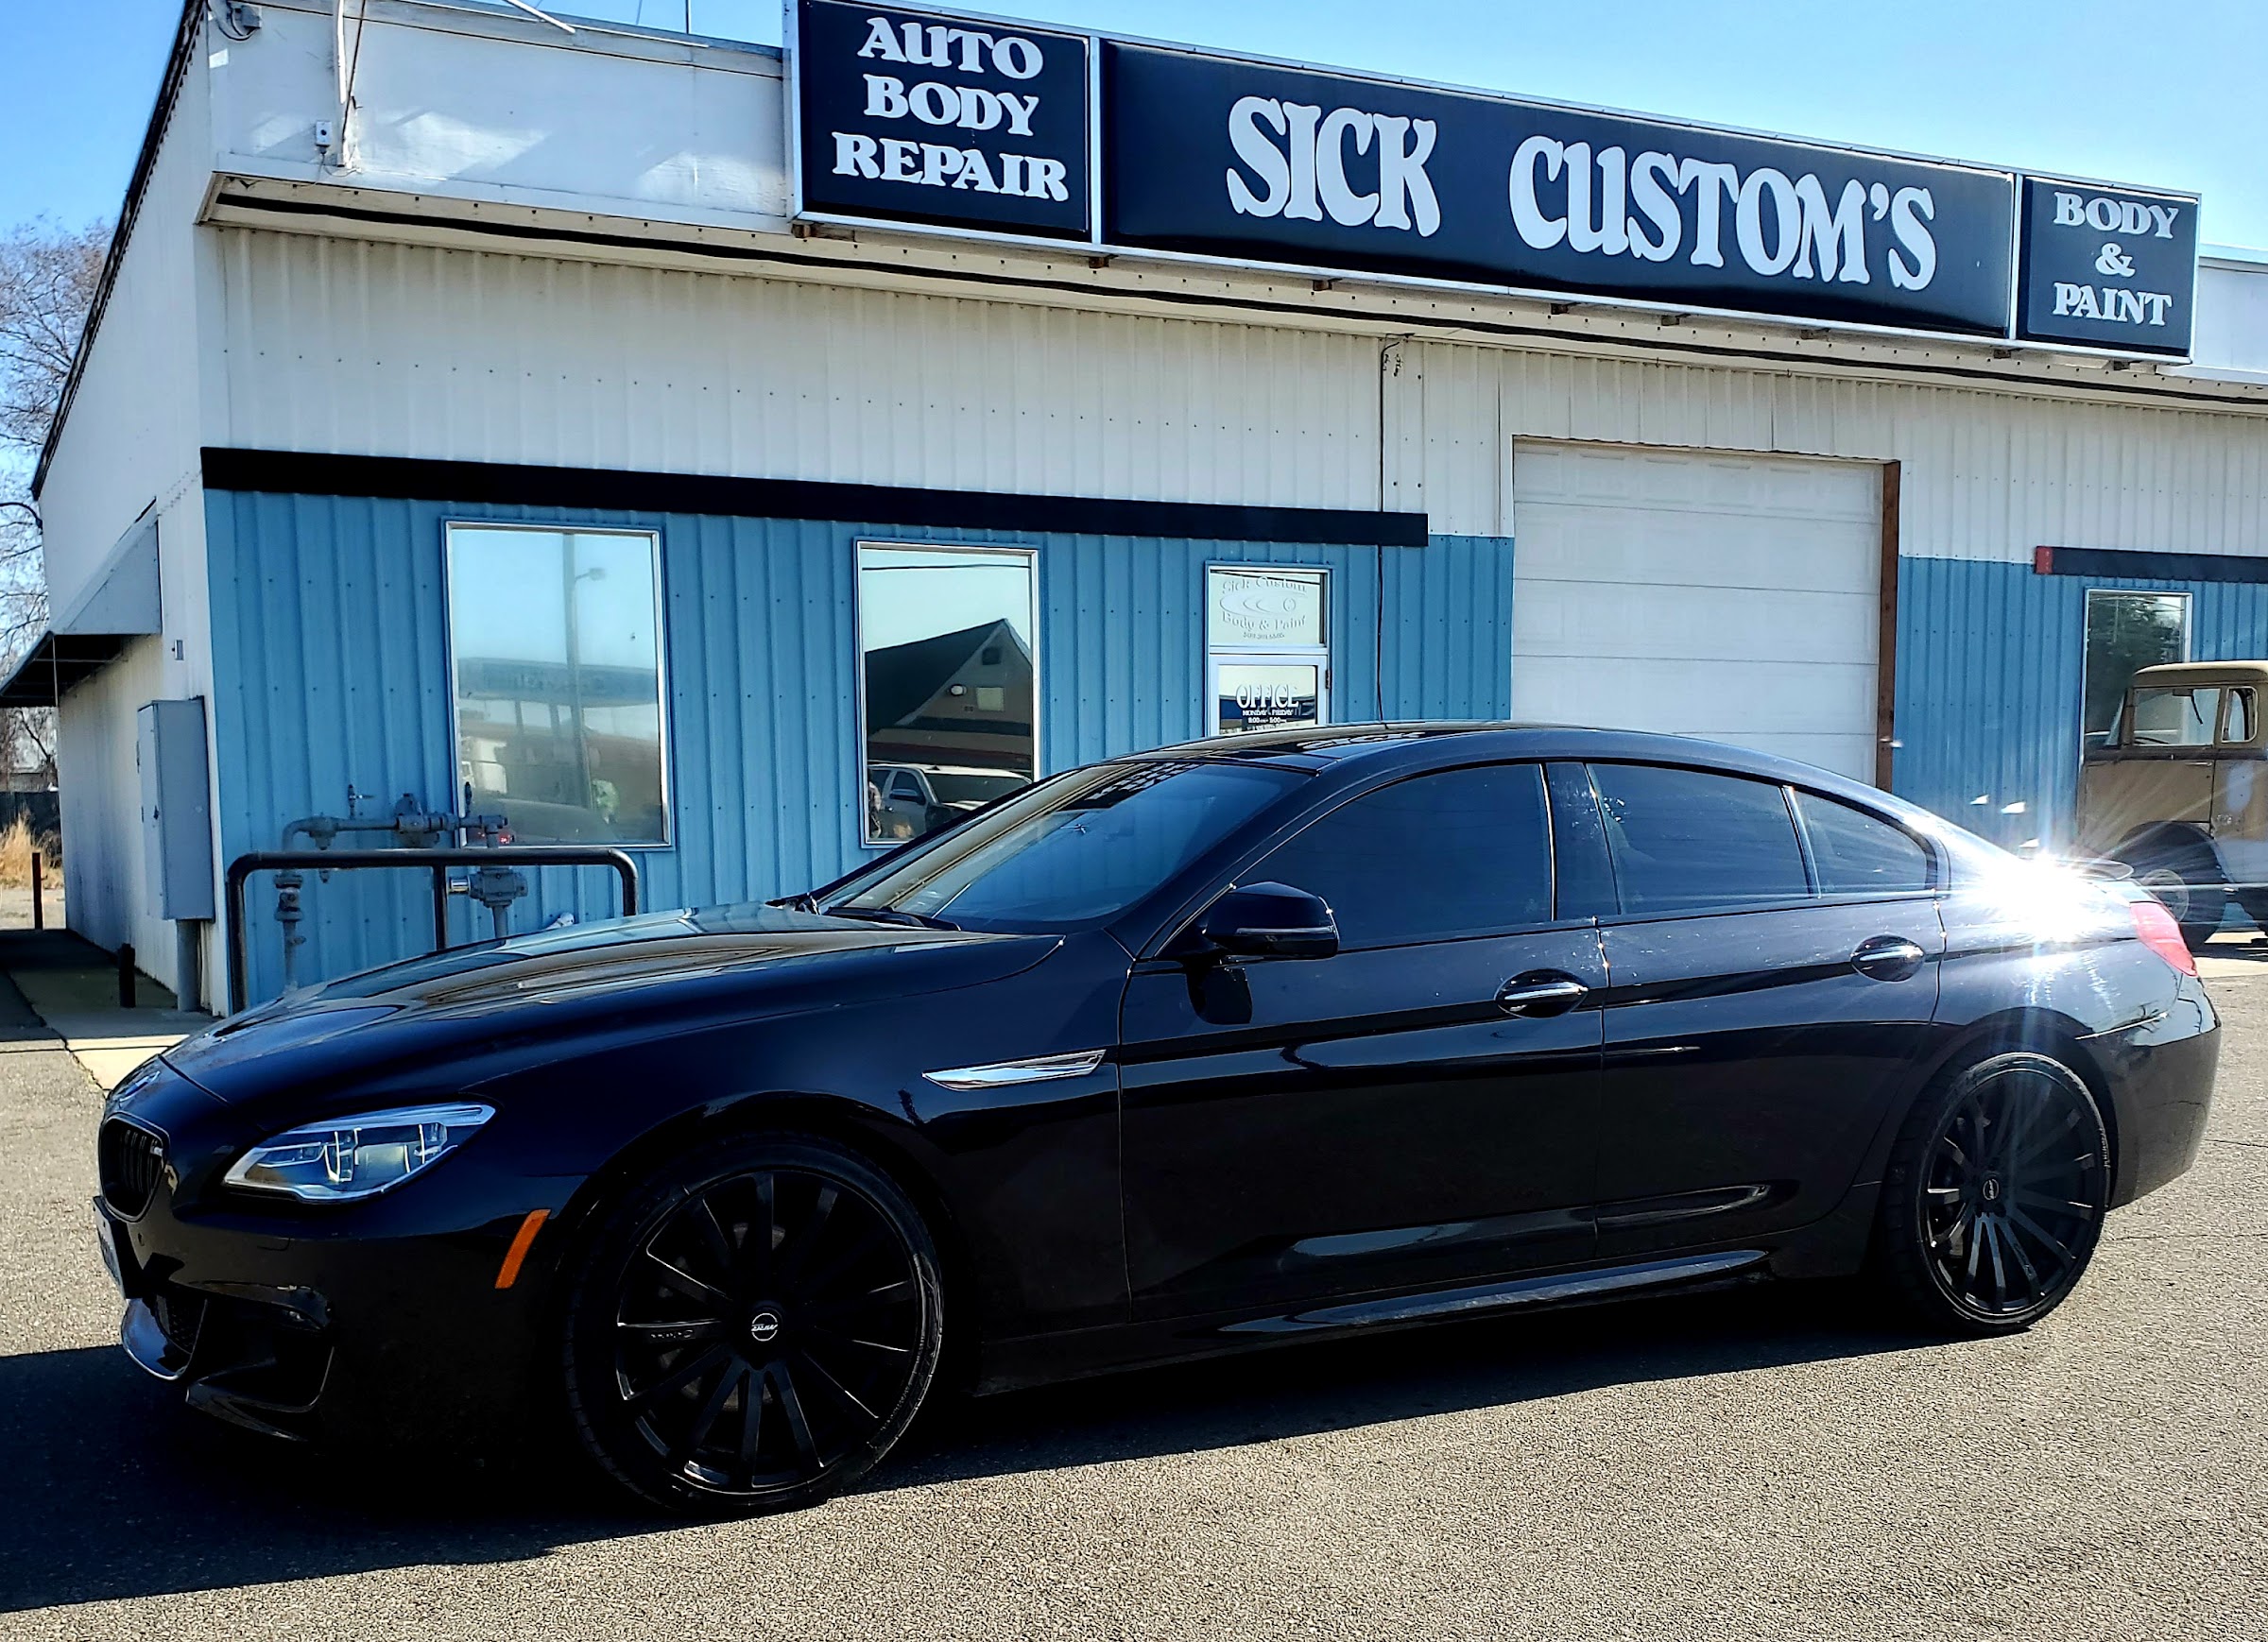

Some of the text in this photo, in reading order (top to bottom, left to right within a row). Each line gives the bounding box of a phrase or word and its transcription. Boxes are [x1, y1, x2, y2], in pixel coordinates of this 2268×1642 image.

[857, 16, 1043, 80] AUTO
[862, 73, 1040, 137] BODY
[831, 131, 1069, 202] REPAIR
[1226, 95, 1936, 292] SICK CUSTOM'S
[2053, 191, 2179, 239] BODY
[2094, 242, 2136, 278] &
[2052, 282, 2173, 326] PAINT
[1222, 578, 1250, 594] Sick
[1222, 610, 1307, 632] Body & Paint
[1236, 684, 1299, 709] OFFICE
